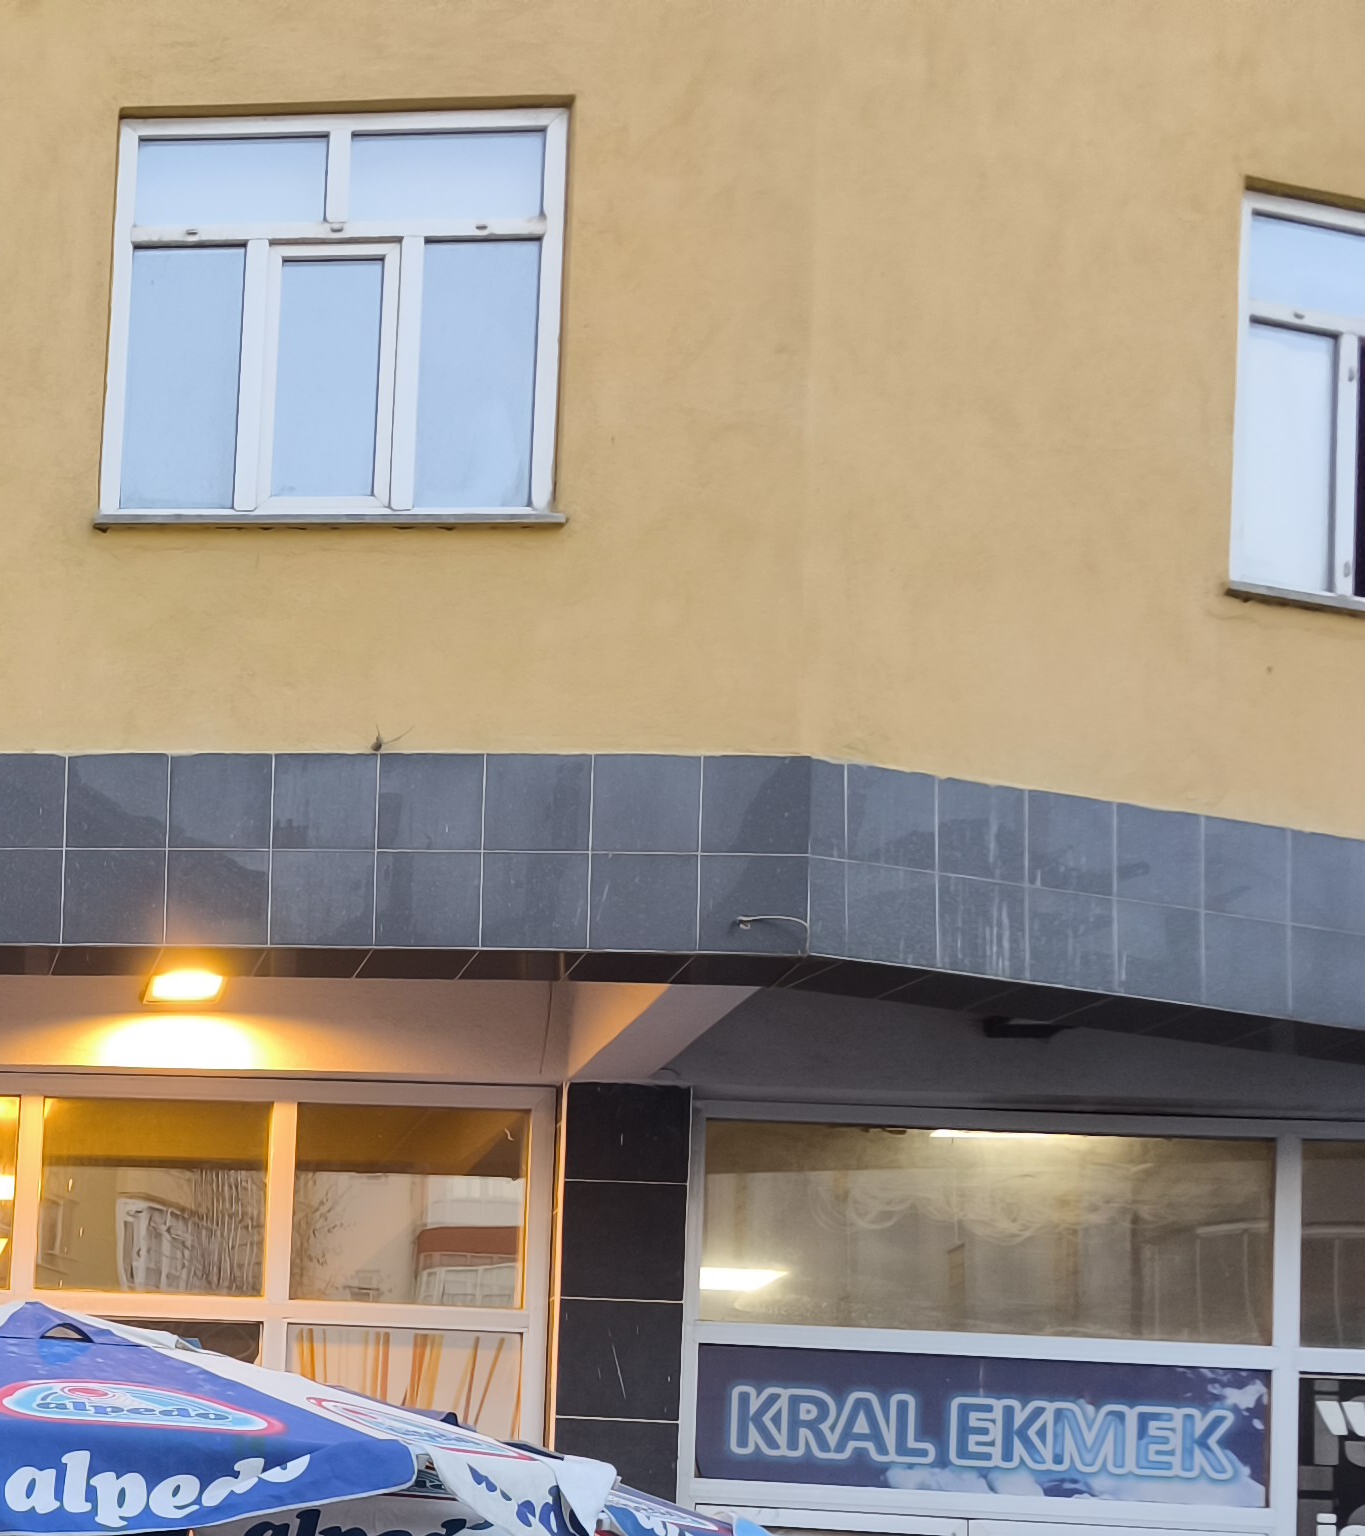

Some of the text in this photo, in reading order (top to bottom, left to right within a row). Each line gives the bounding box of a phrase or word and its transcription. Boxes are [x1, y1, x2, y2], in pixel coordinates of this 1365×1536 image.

[35, 1399, 232, 1422] alpedo
[729, 1385, 936, 1466] KRAL
[949, 1395, 1236, 1480] EKMEK
